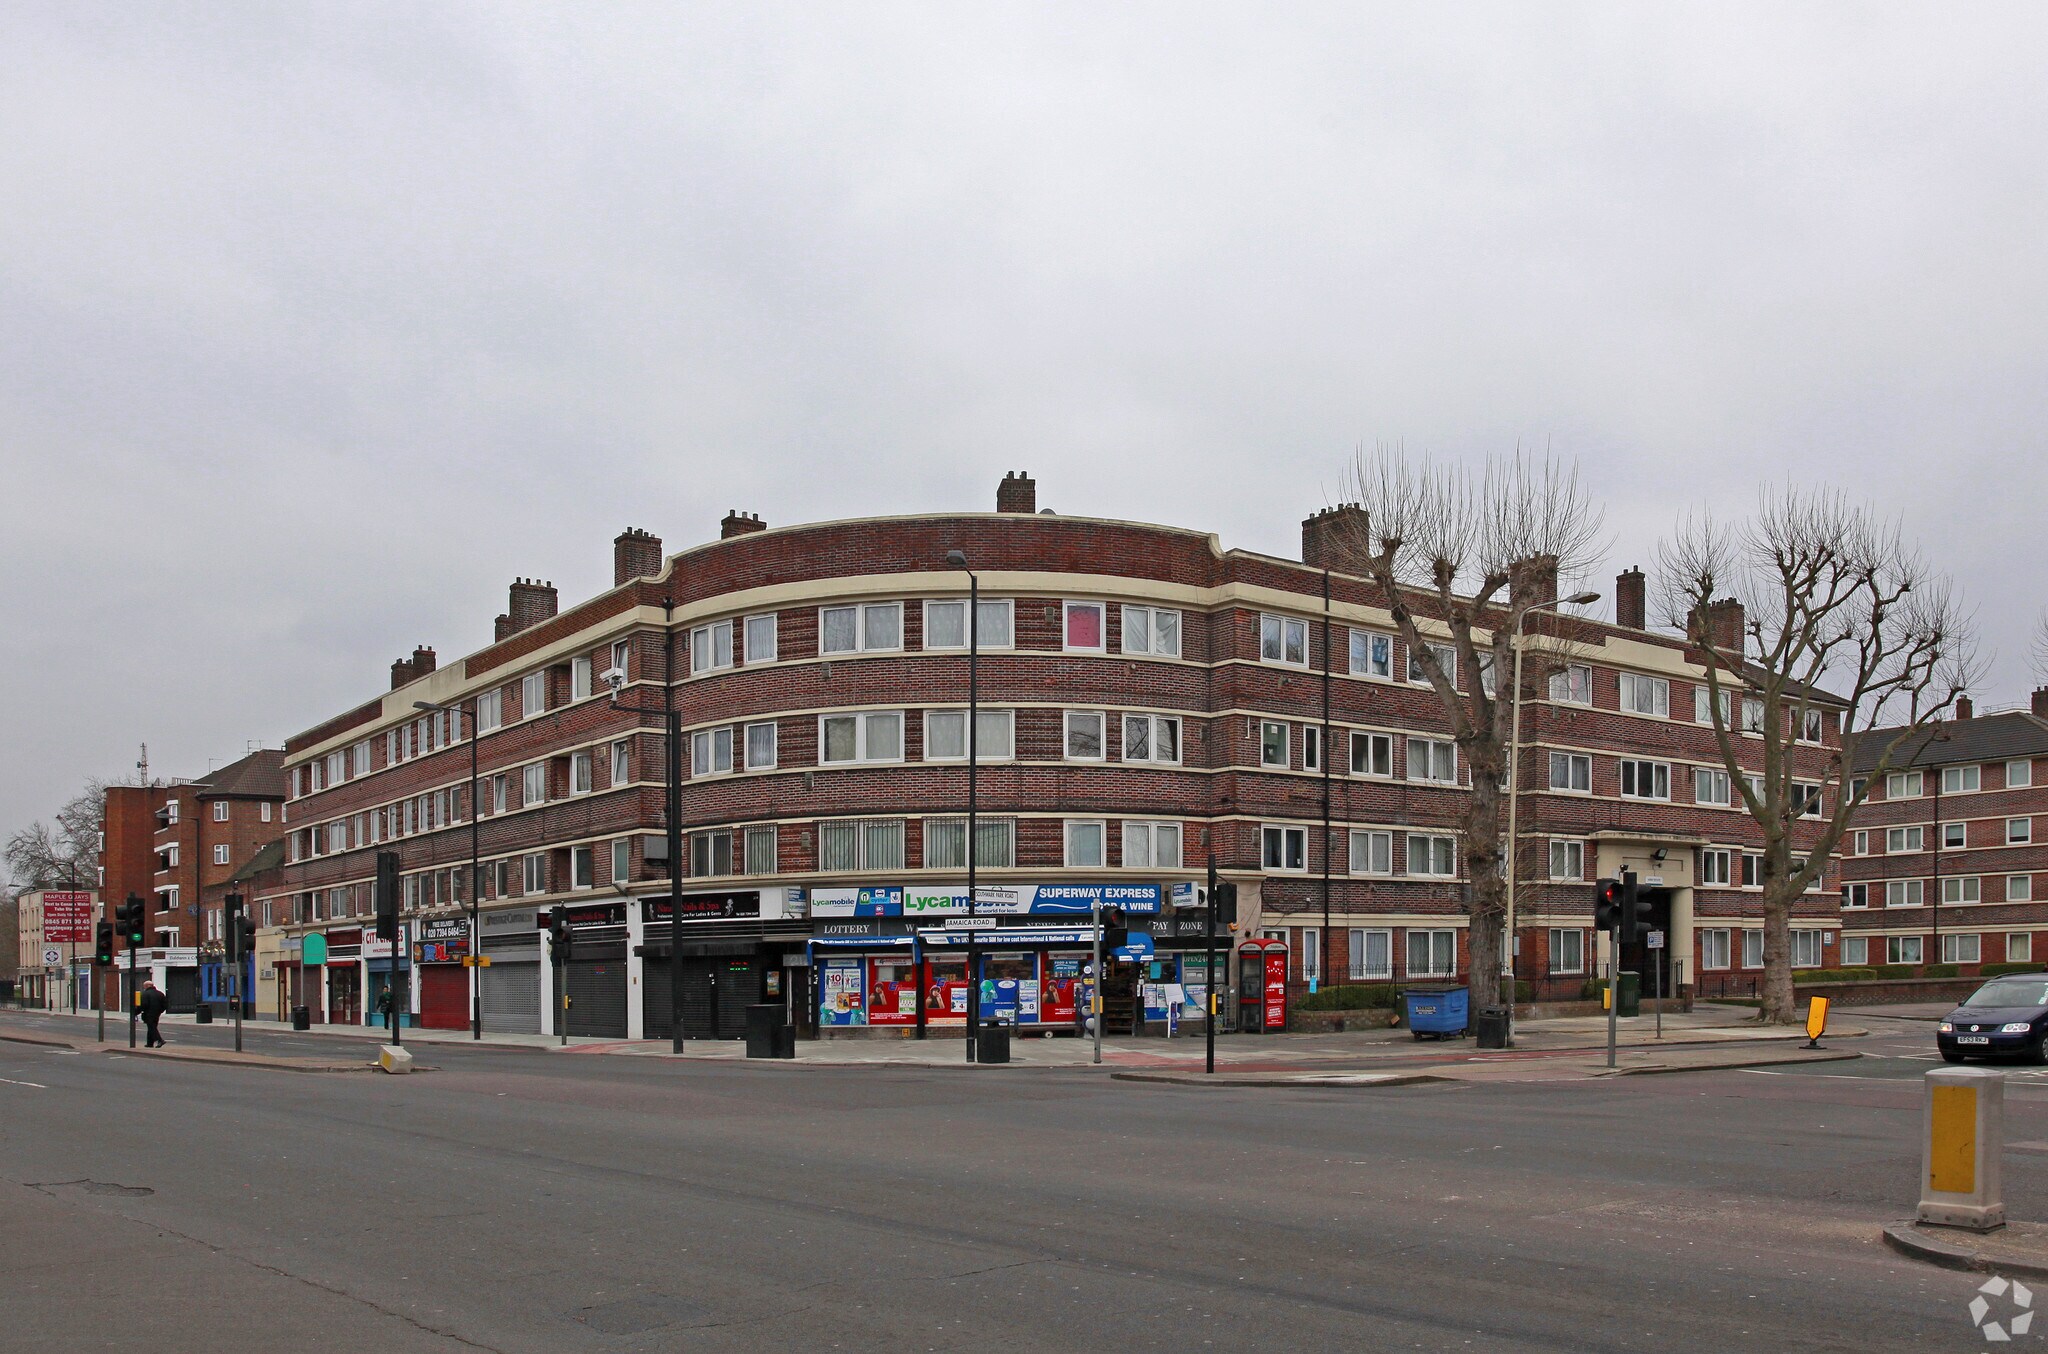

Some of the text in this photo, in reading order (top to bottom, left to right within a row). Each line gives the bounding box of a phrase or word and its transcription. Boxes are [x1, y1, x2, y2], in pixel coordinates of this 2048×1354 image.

[1039, 888, 1155, 898] SUPERWAY EXPRESS
[812, 896, 855, 906] Lycamobile
[824, 925, 870, 934] LOTTERY
[1153, 921, 1168, 930] PAY
[1180, 922, 1202, 930] ZONE
